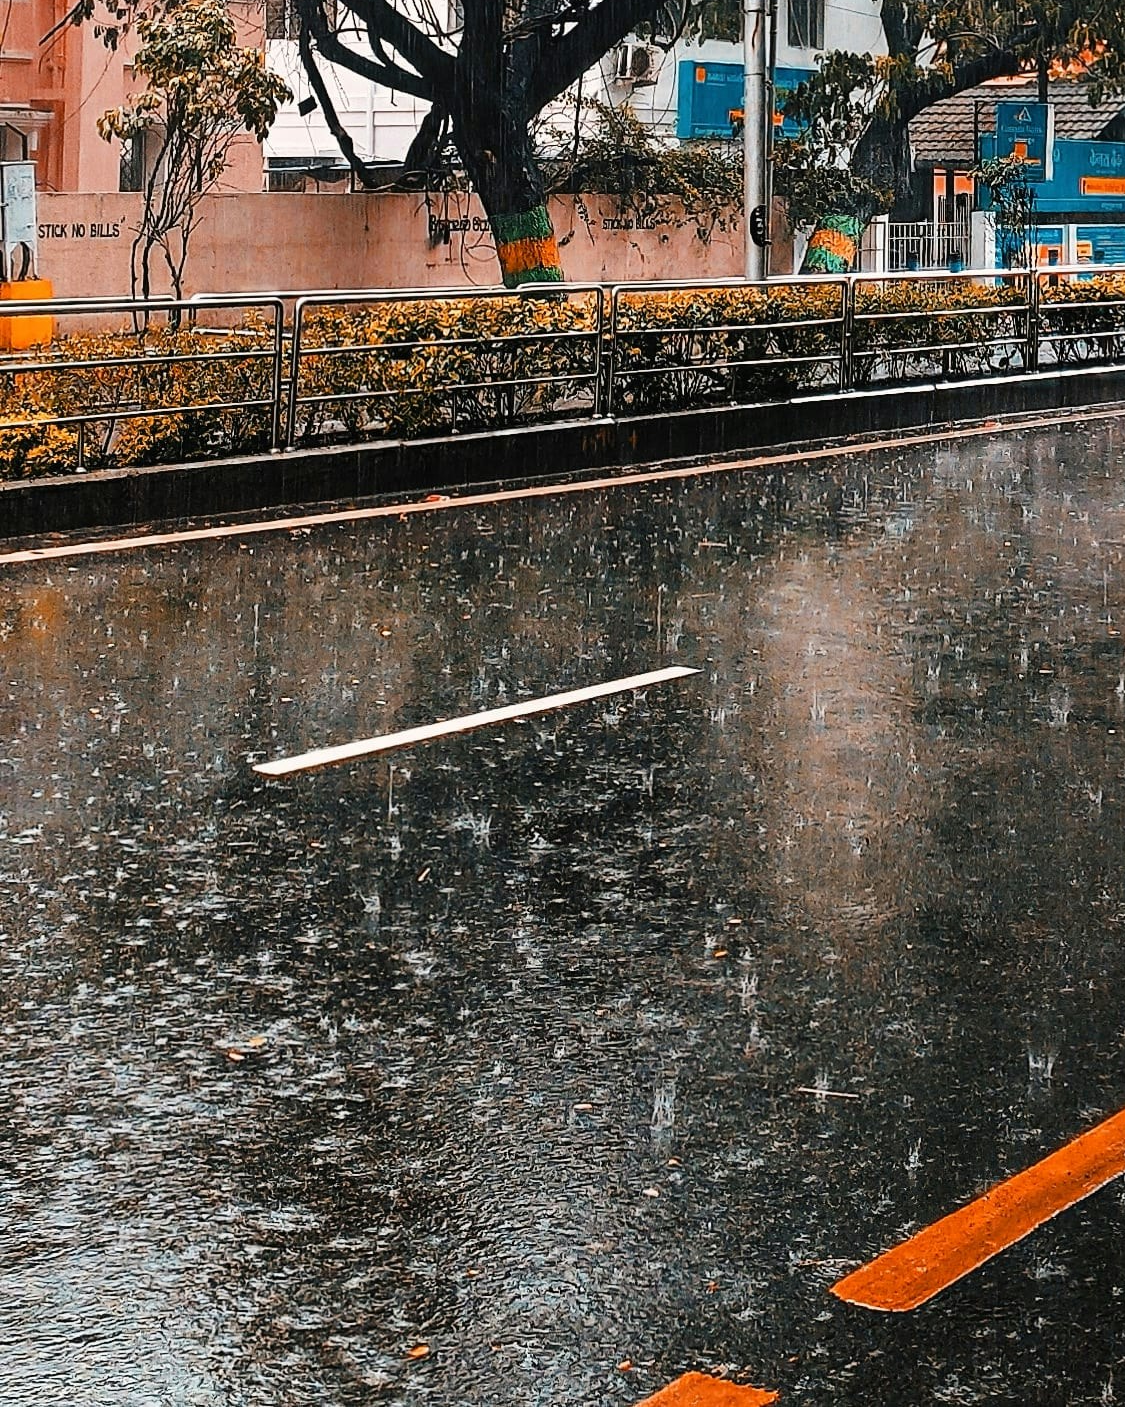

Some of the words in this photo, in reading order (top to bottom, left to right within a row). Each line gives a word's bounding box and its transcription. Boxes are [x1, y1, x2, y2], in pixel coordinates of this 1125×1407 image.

[38, 223, 67, 238] STICK
[72, 223, 85, 238] NO
[90, 223, 120, 238] BILLS
